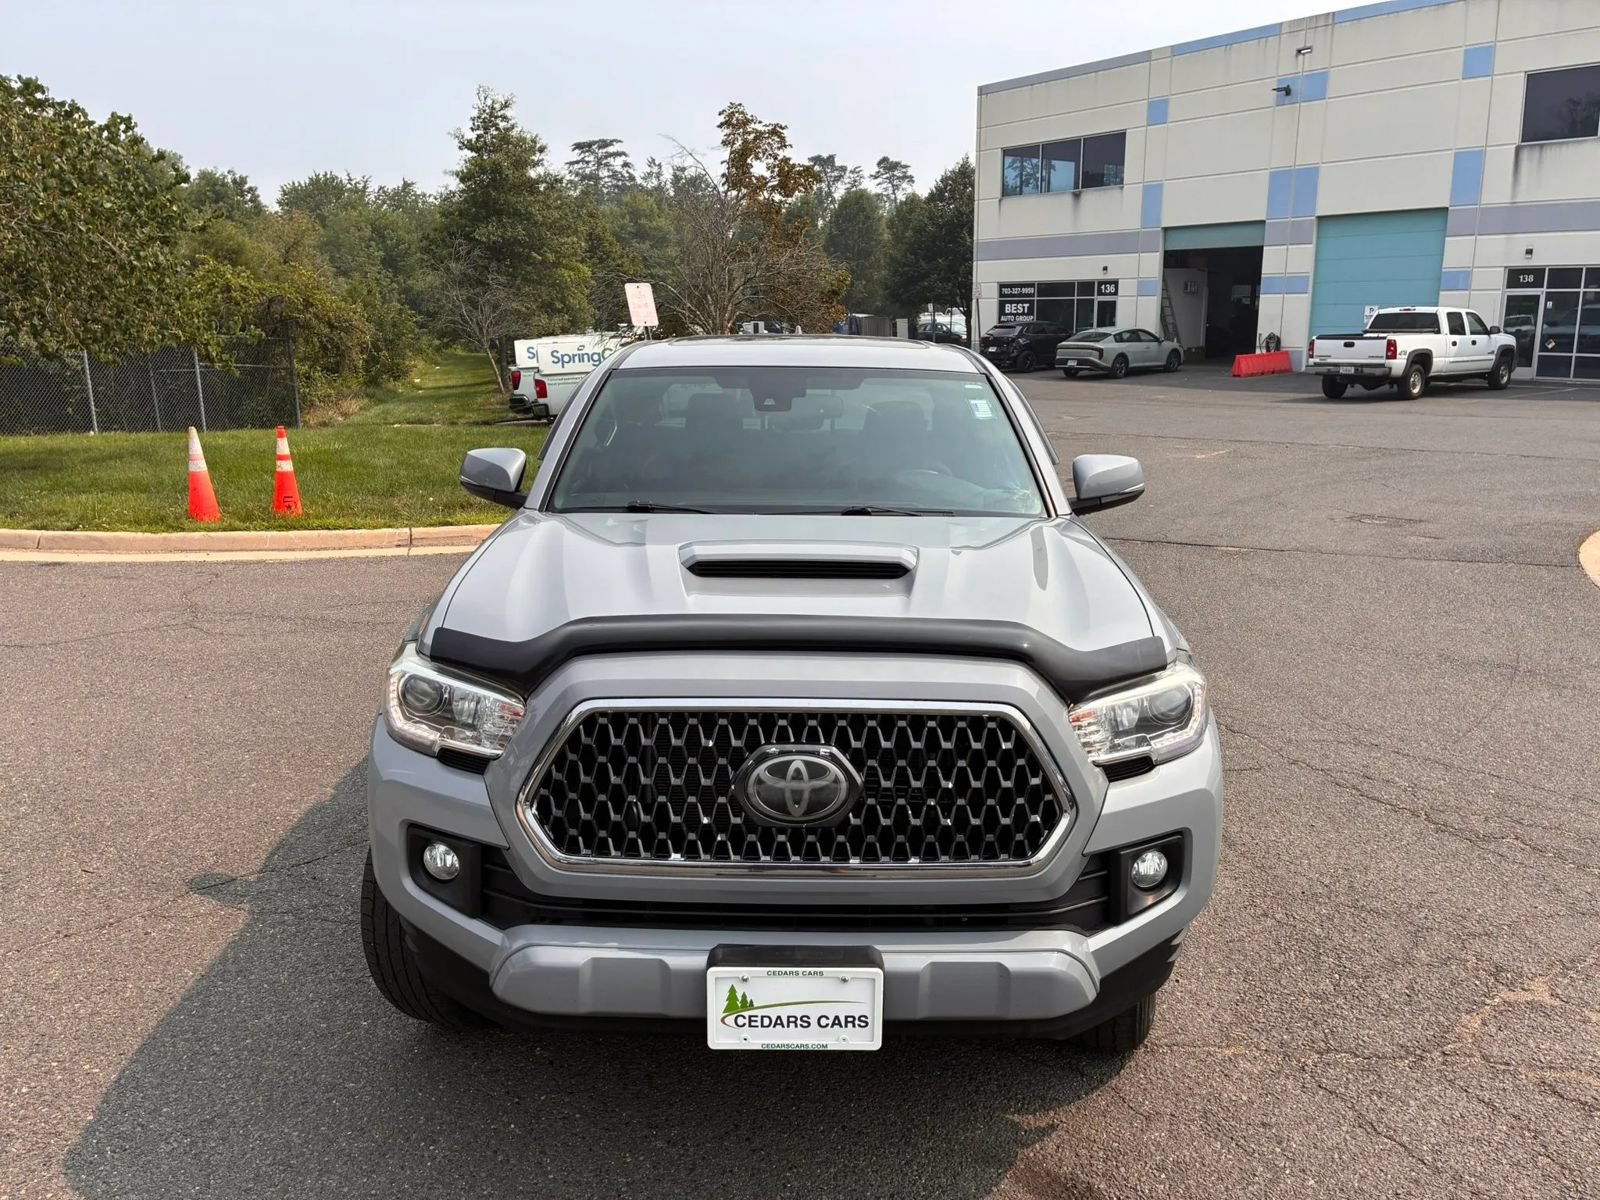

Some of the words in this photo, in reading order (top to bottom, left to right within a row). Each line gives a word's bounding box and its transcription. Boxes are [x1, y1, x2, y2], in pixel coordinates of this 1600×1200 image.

[1519, 274, 1534, 283] 138
[1100, 284, 1116, 293] 136
[1005, 303, 1030, 313] BEST
[734, 1014, 811, 1029] CEDARS
[816, 1014, 869, 1029] CARS
[761, 1042, 828, 1050] CEDARSCARS.COM
